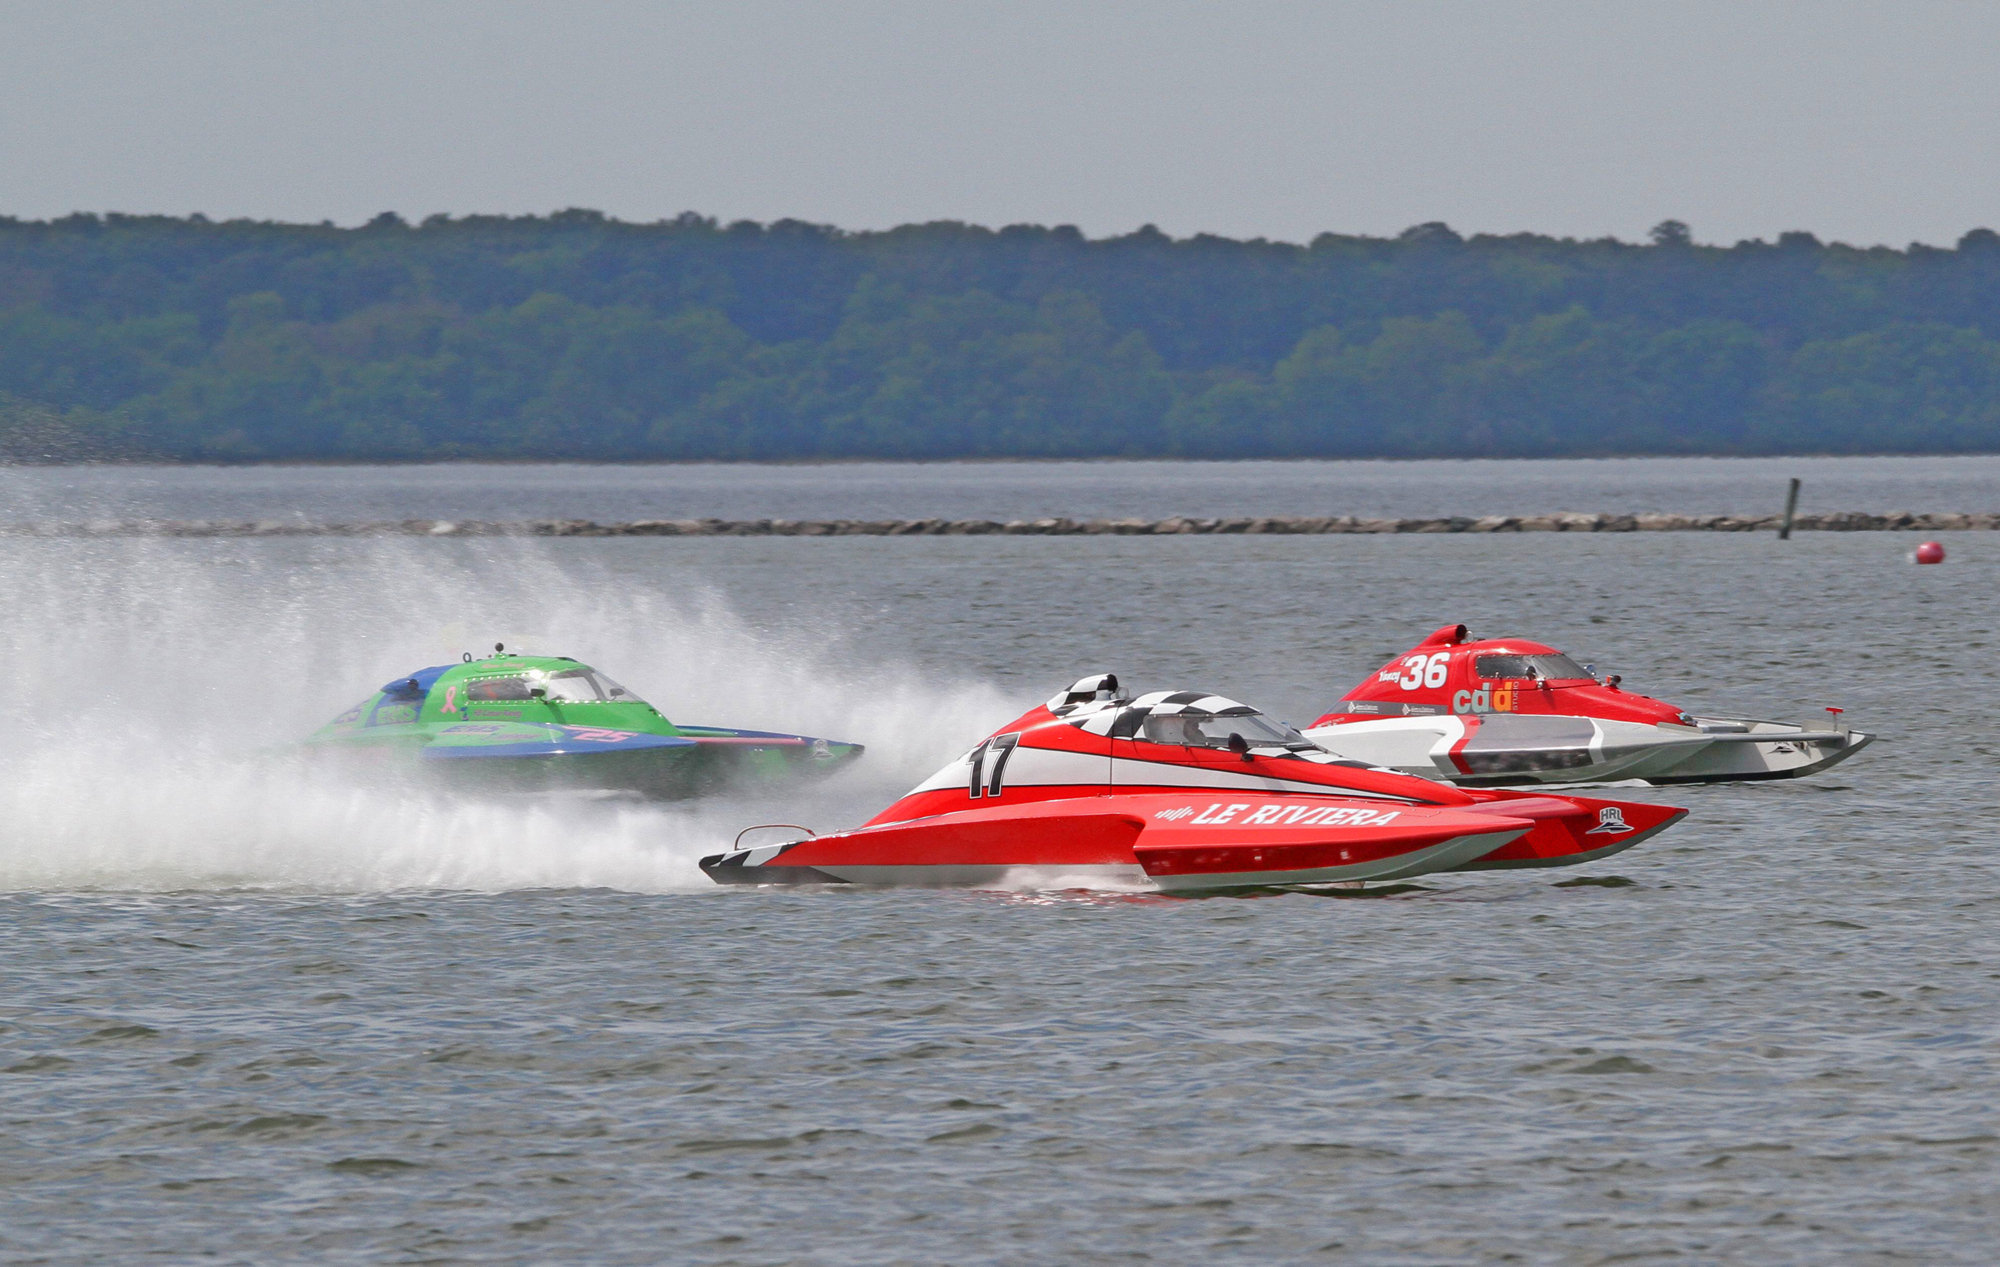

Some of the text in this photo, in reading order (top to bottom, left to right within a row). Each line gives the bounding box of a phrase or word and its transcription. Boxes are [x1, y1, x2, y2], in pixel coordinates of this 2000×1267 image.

[1400, 652, 1450, 690] 36
[561, 725, 639, 743] 25
[966, 731, 1021, 799] 17
[1190, 804, 1402, 826] LE RIVIERA
[1600, 807, 1623, 822] HRL
